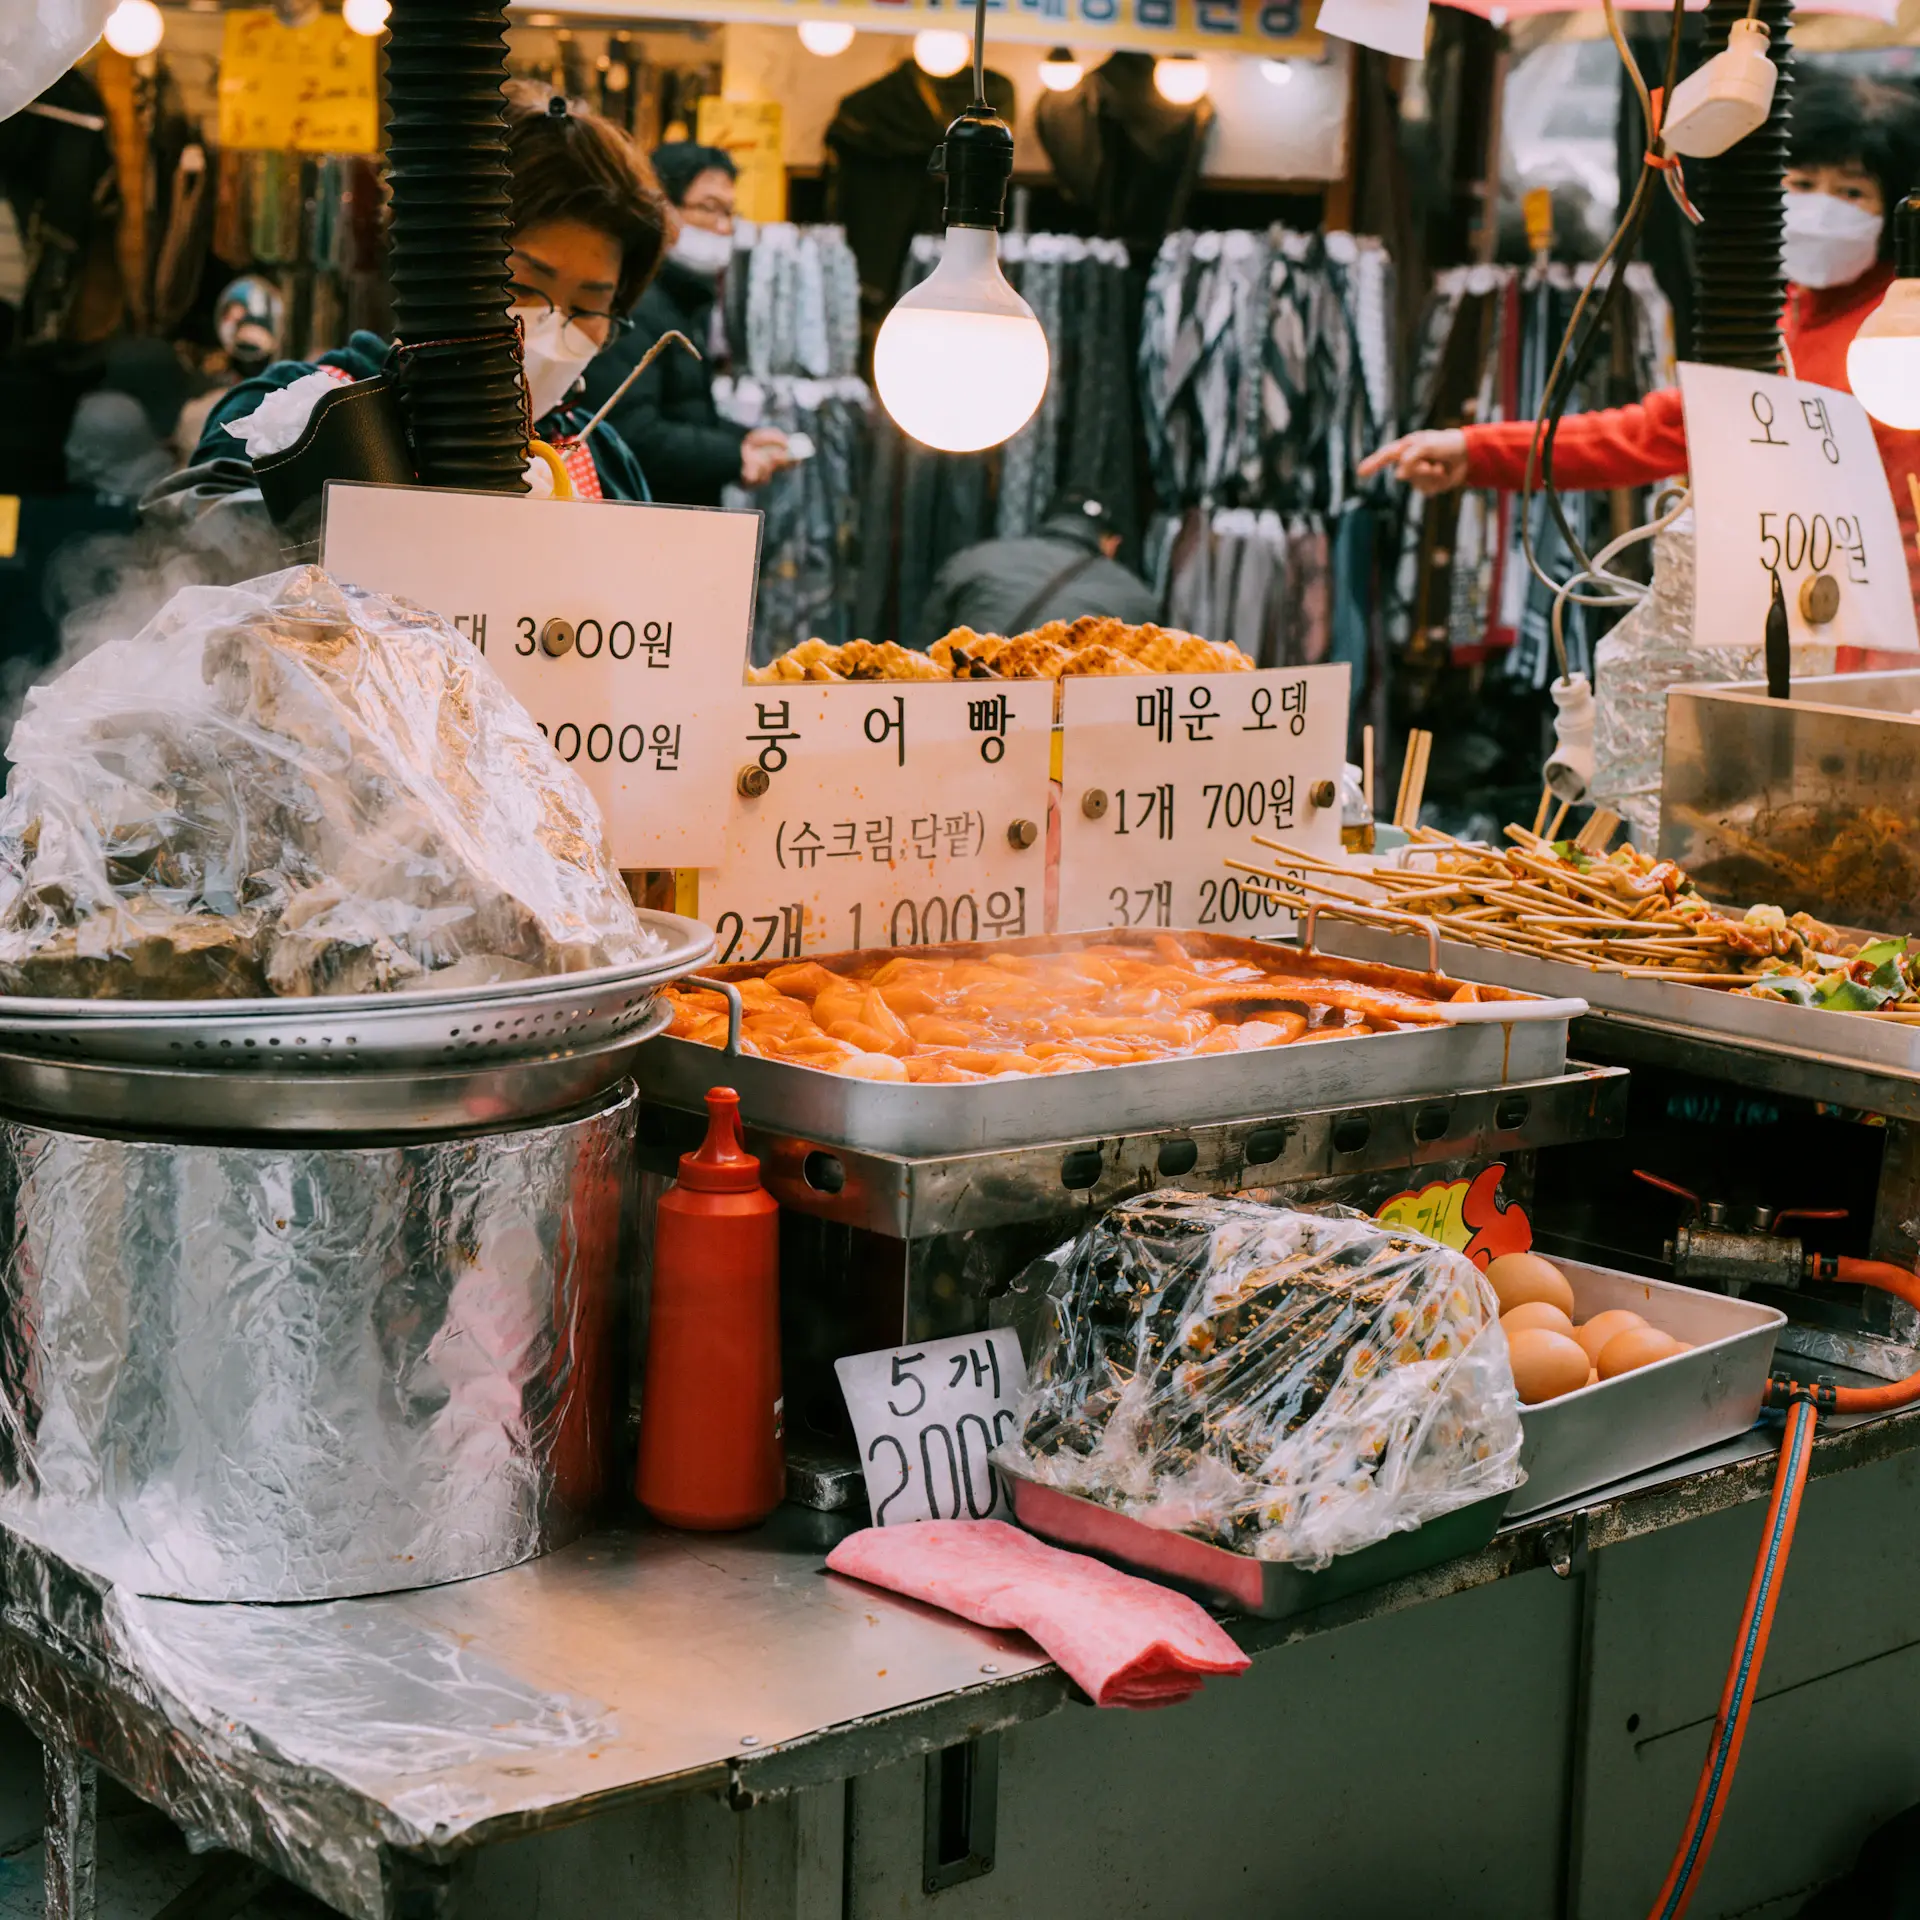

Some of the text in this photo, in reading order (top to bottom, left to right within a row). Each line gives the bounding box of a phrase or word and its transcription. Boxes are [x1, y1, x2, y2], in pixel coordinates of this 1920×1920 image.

[1759, 512, 1869, 584] 500원
[514, 615, 673, 669] 300원
[1135, 679, 1308, 744] 매운 오뎅
[1113, 774, 1296, 841] 1개 700원
[715, 902, 804, 965] 2개
[1107, 879, 1173, 928] 3개
